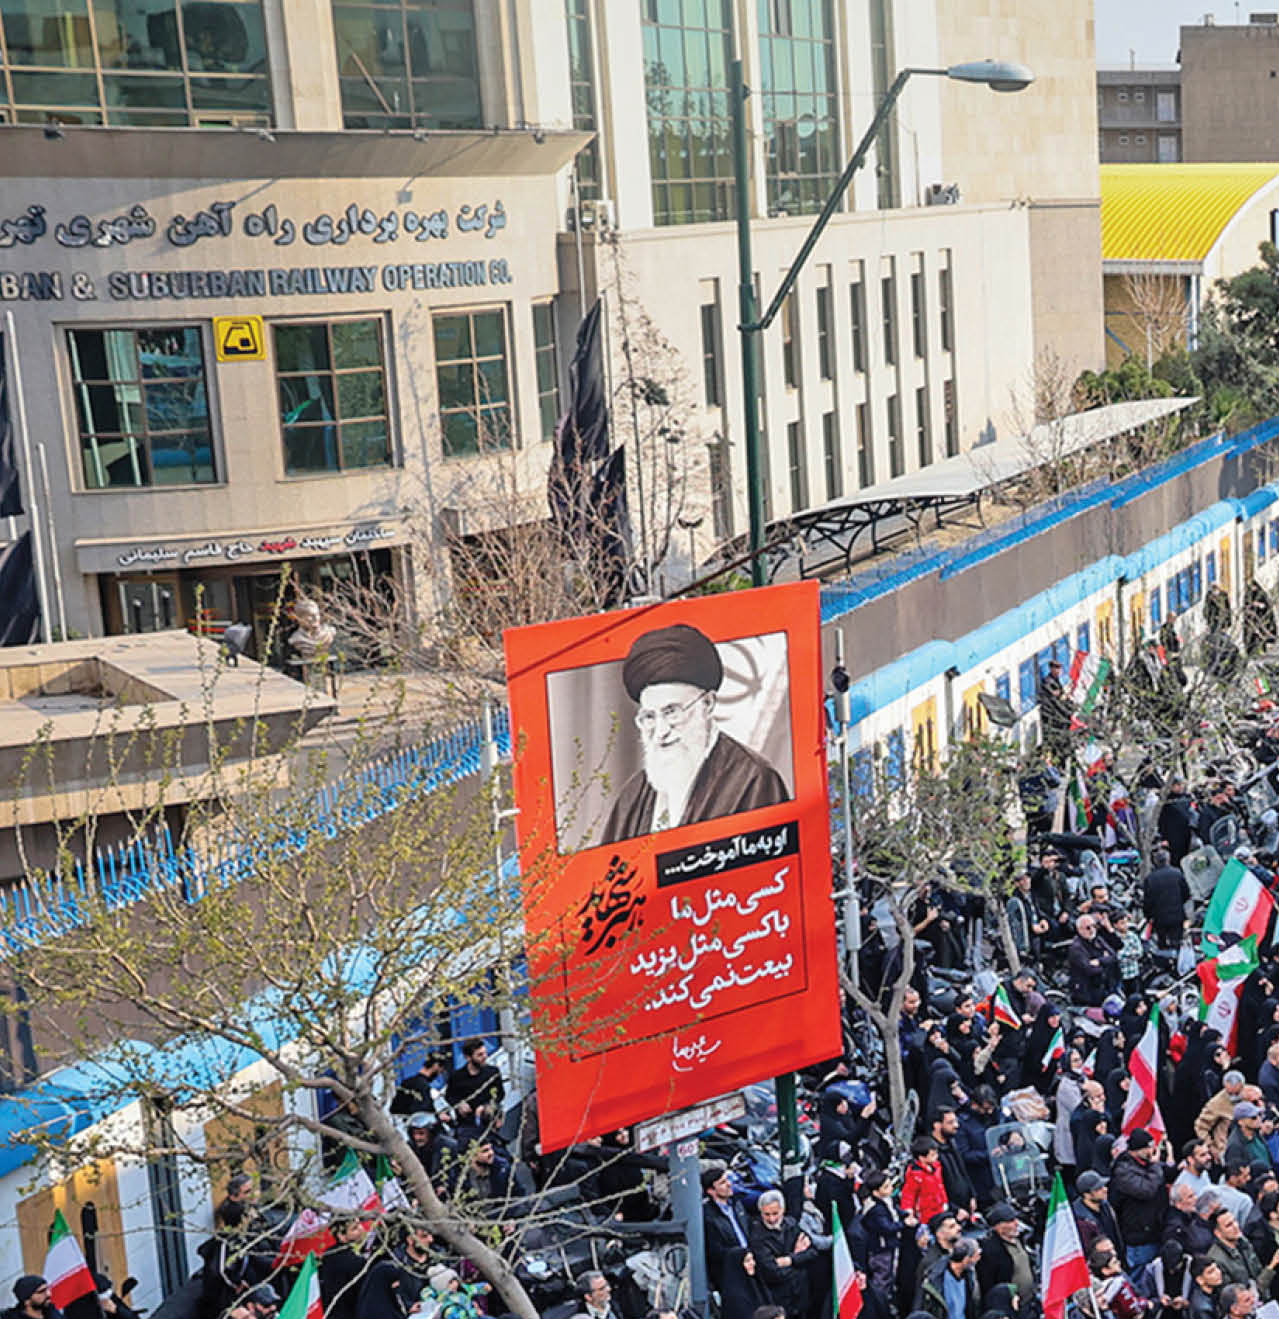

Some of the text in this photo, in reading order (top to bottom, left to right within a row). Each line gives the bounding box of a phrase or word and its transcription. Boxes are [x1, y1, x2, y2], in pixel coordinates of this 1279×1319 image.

[55, 204, 156, 248] شهری
[168, 201, 237, 247] آهن
[244, 203, 295, 246] راه
[303, 203, 398, 246] برداری
[404, 210, 449, 242] بهره
[457, 200, 507, 240] شرکت
[71, 272, 97, 300] &
[109, 269, 266, 300] SUBURBAN
[269, 266, 377, 296] RAILWAY
[382, 260, 487, 292] OPERATION
[118, 549, 179, 566] سلیمانی
[183, 542, 222, 563] قاسم
[226, 541, 254, 559] حاج
[259, 537, 297, 553] شهید
[670, 866, 790, 927] کسی مثل ما
[630, 909, 790, 977] با کسی مثل یزید
[735, 952, 793, 987] بیعت
